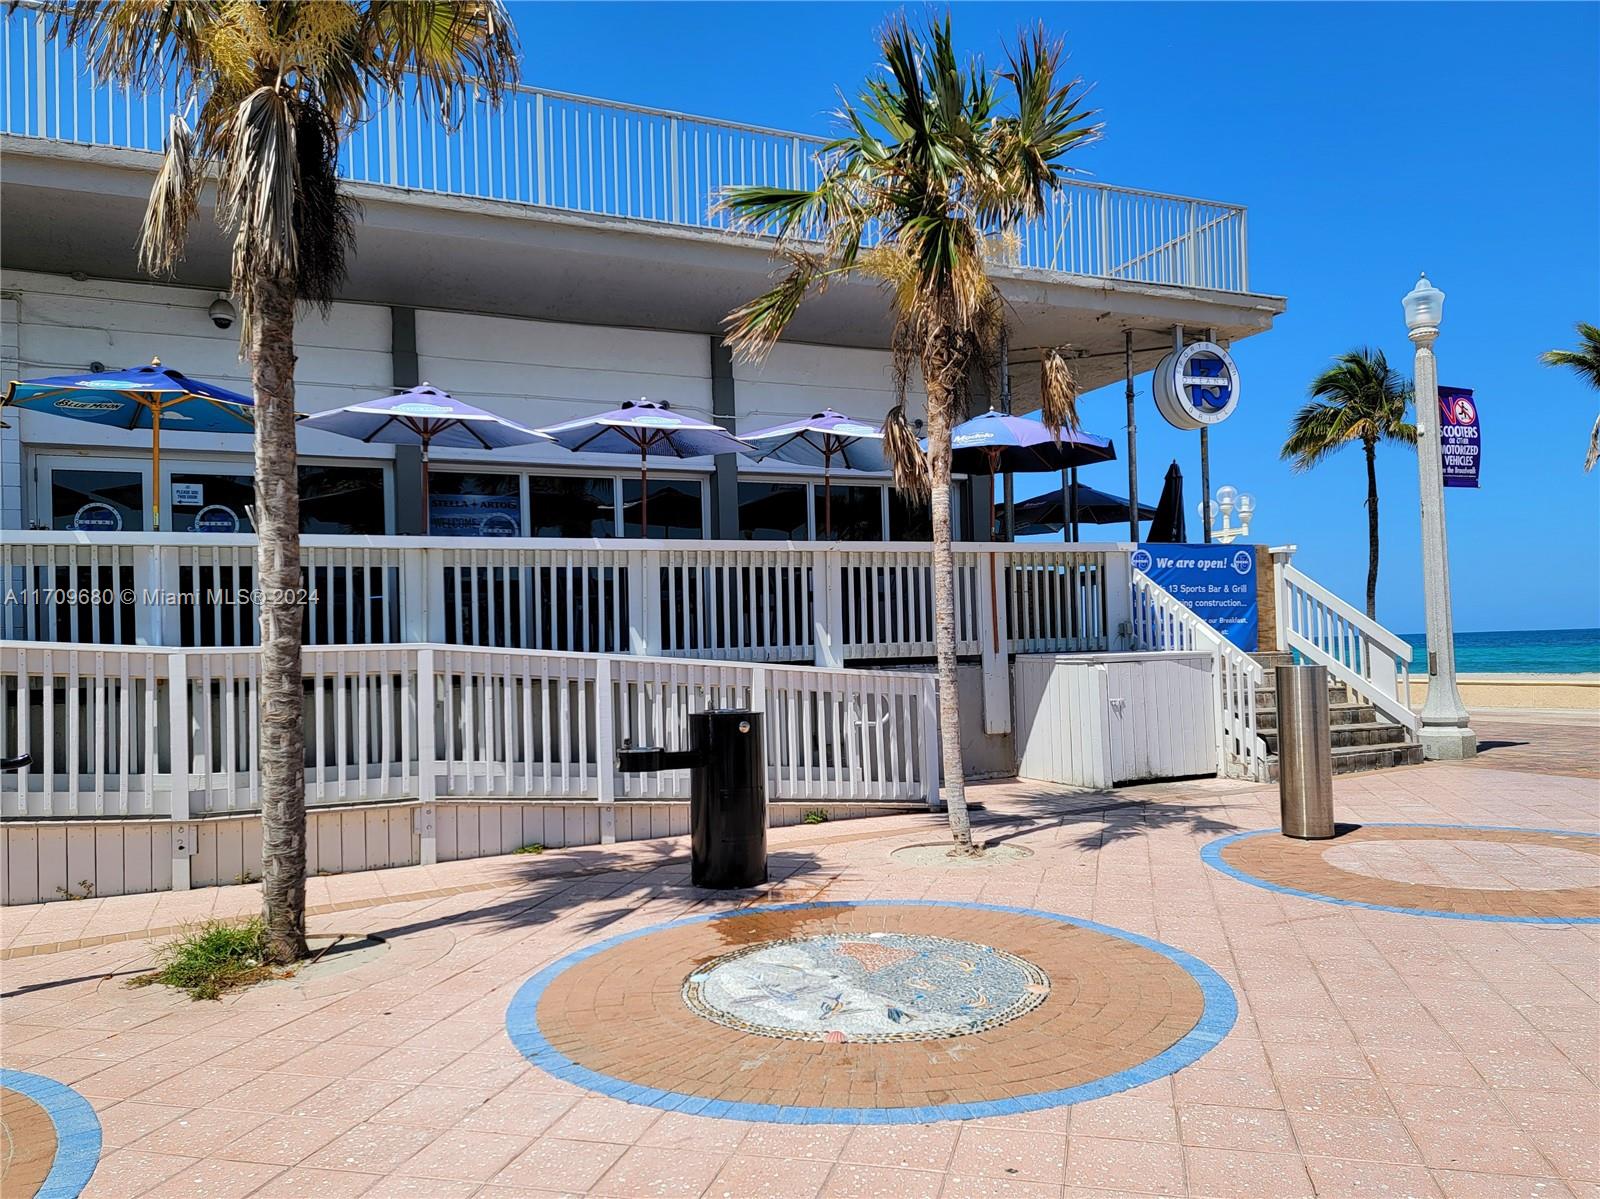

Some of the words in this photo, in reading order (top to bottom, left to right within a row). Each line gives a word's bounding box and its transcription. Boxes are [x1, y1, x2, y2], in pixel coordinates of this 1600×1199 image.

[56, 399, 88, 408] BLUE
[89, 402, 120, 410] MOON
[1444, 455, 1473, 466] VEHICLES
[431, 499, 469, 509] STELLA
[480, 501, 517, 509] ARTOIS
[1156, 557, 1173, 568] We
[1176, 560, 1195, 568] are
[1197, 557, 1228, 571] open!
[1168, 584, 1178, 593] 13
[1180, 584, 1206, 595] Sports
[1208, 584, 1221, 593] Bar
[1223, 584, 1230, 593] &
[1232, 584, 1247, 593] Grill
